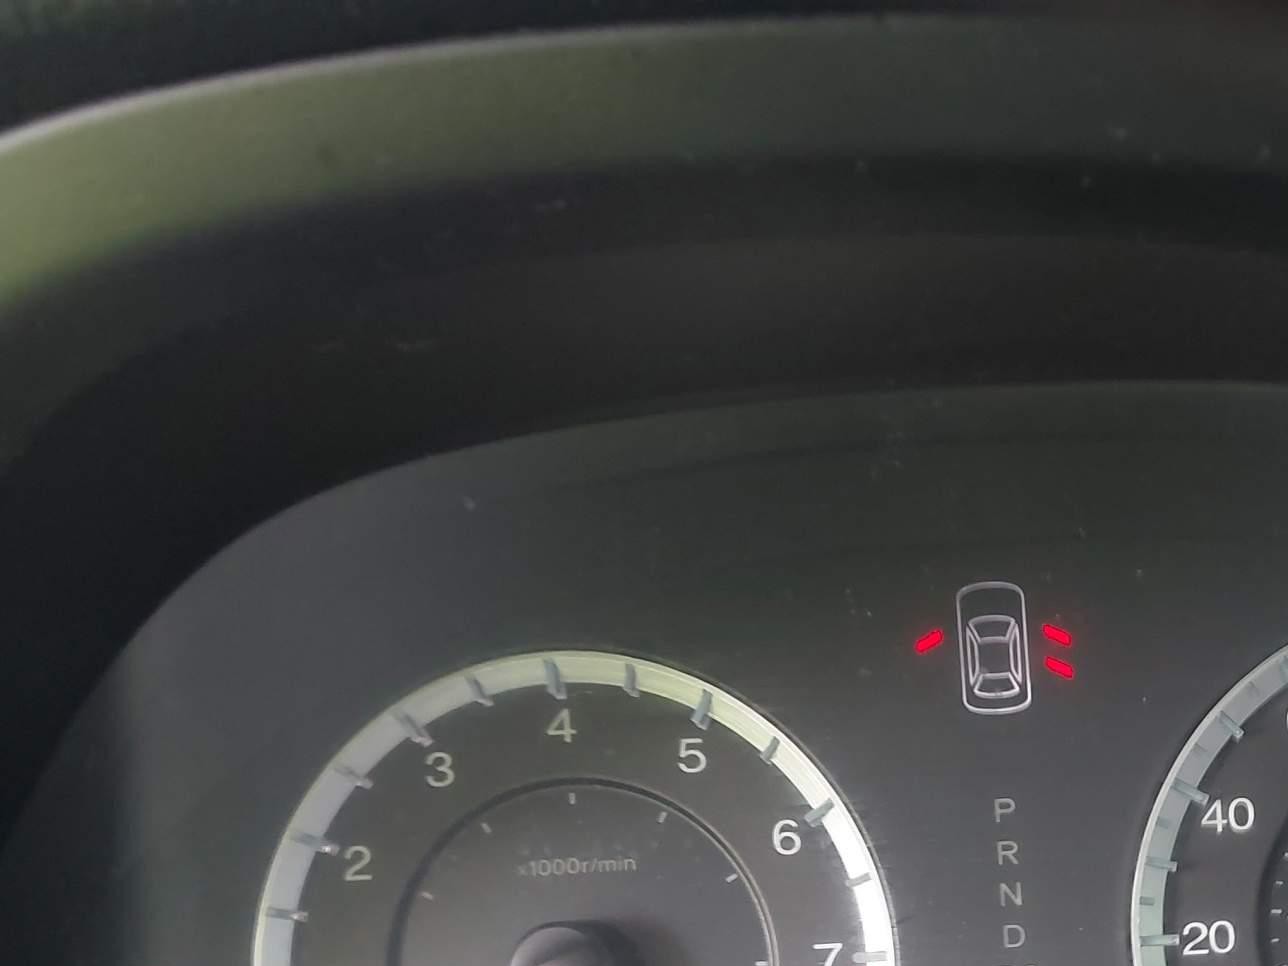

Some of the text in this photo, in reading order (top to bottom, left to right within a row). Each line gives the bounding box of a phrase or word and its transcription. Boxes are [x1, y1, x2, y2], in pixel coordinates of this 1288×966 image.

[546, 709, 576, 742] 4
[425, 752, 454, 787] 3
[678, 738, 707, 773] 5
[994, 798, 1016, 823] P
[1201, 798, 1254, 833] 40
[772, 819, 801, 855] 6
[998, 841, 1018, 864] R
[343, 847, 371, 881] 2
[1000, 883, 1022, 906] N
[1004, 925, 1025, 948] D
[1182, 920, 1235, 955] 20
